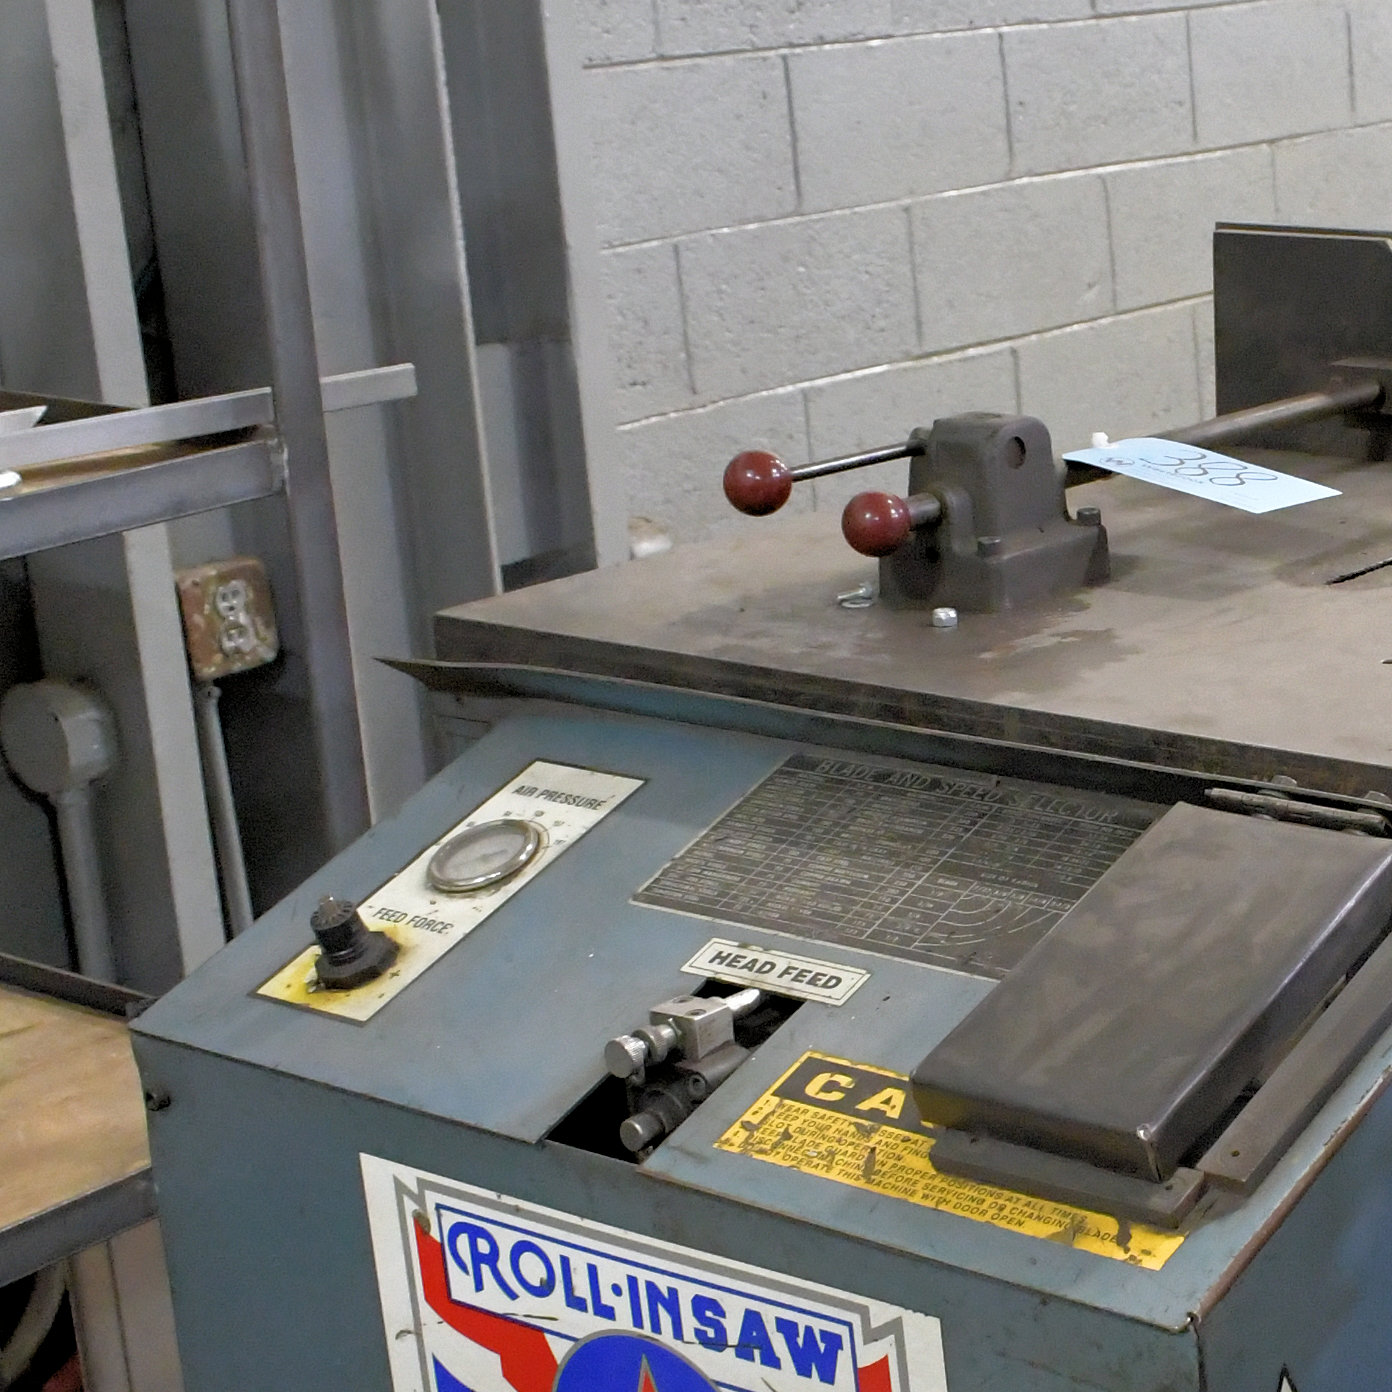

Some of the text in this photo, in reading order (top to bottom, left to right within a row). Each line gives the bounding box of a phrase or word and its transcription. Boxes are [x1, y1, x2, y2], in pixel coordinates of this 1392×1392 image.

[1138, 449, 1279, 487] 388
[512, 785, 608, 811] AIR PRESSURE
[815, 759, 878, 782] BLADE
[885, 769, 932, 789] AND
[935, 780, 1002, 802] SPEED
[372, 907, 455, 935] FEED FORCE
[708, 950, 843, 990] HEAD FEED
[801, 1118, 833, 1132] YOUR
[874, 1139, 900, 1151] AND
[838, 1139, 904, 1162] OPERTION
[791, 1135, 823, 1149] LADE
[890, 1162, 938, 1182] PROPER
[939, 1176, 1004, 1200] POSITIONS
[1004, 1195, 1022, 1204] AT
[837, 1168, 862, 1182] THIS
[952, 1201, 989, 1217] DOOR
[921, 1182, 986, 1206] SERVICING
